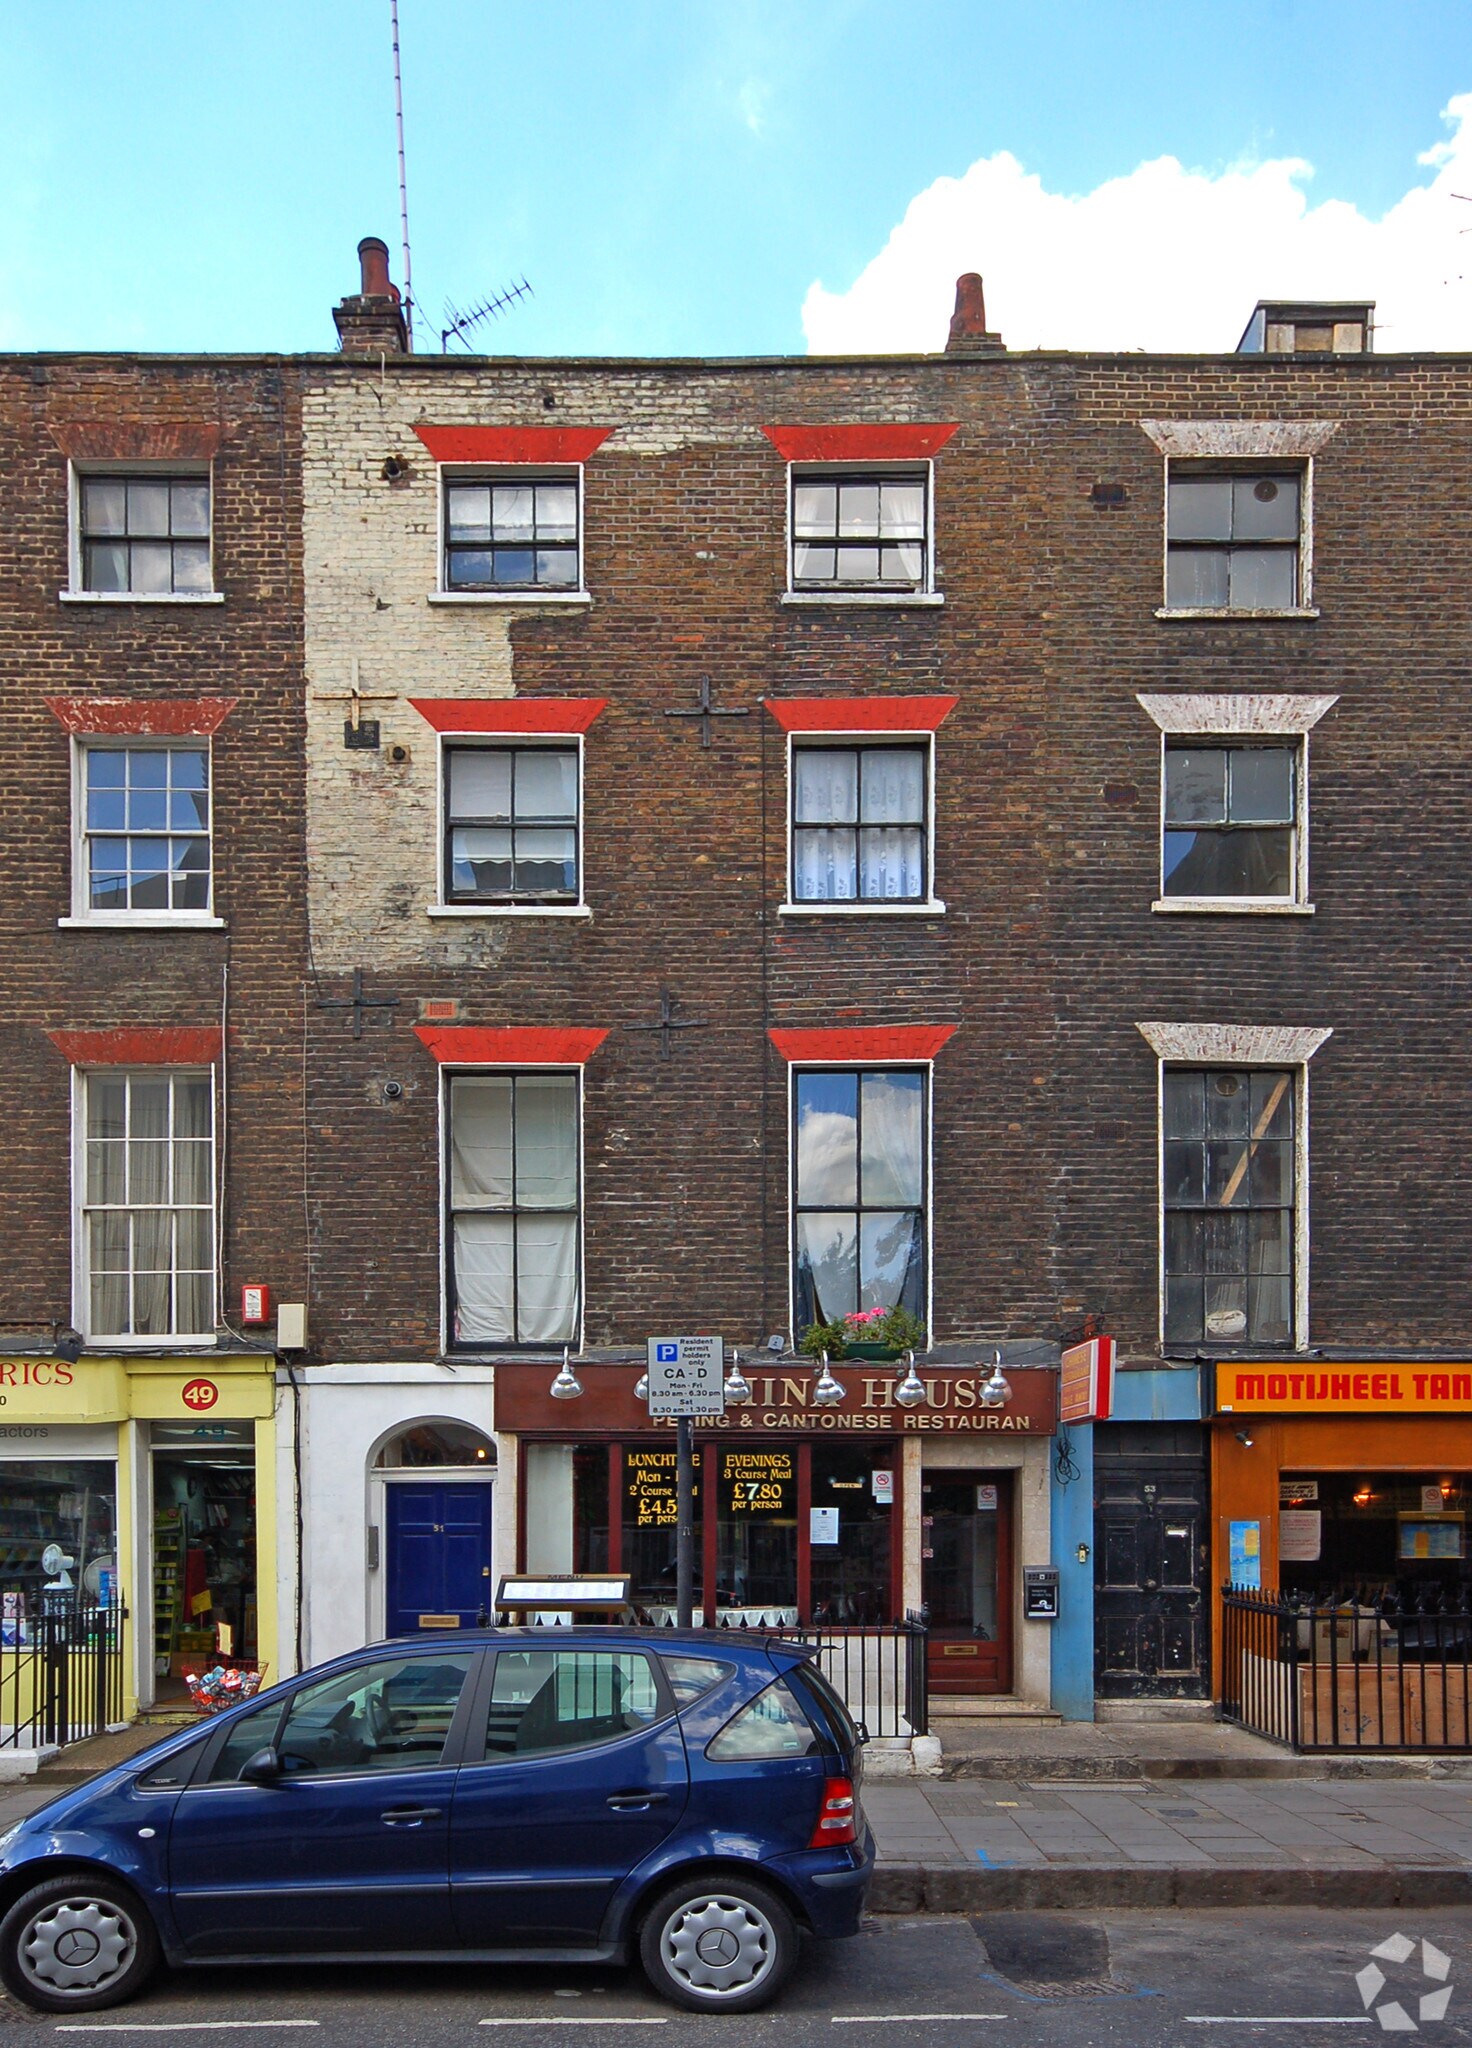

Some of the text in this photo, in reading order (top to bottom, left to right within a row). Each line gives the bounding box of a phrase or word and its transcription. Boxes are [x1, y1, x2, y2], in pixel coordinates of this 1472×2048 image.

[661, 1345, 675, 1360] P
[0, 1362, 73, 1387] RICS
[663, 1368, 685, 1379] CA
[697, 1368, 708, 1379] D
[1235, 1374, 1404, 1400] MOTIJHEEL
[185, 1386, 214, 1404] 49
[653, 1414, 730, 1428] PEING
[740, 1413, 754, 1428] &
[763, 1413, 892, 1429] CANTONESE
[0, 1426, 48, 1438] actors
[193, 1424, 225, 1441] 49
[726, 1454, 791, 1468] EVENINGS
[636, 1470, 661, 1485] Mon
[735, 1468, 768, 1479] Course
[770, 1468, 792, 1481] Meal
[629, 1484, 638, 1496] 2
[640, 1484, 673, 1496] Course
[733, 1482, 782, 1500] £7.80
[1144, 1485, 1156, 1493] 53
[732, 1500, 783, 1511] per person
[637, 1515, 653, 1526] per
[433, 1524, 445, 1533] 51
